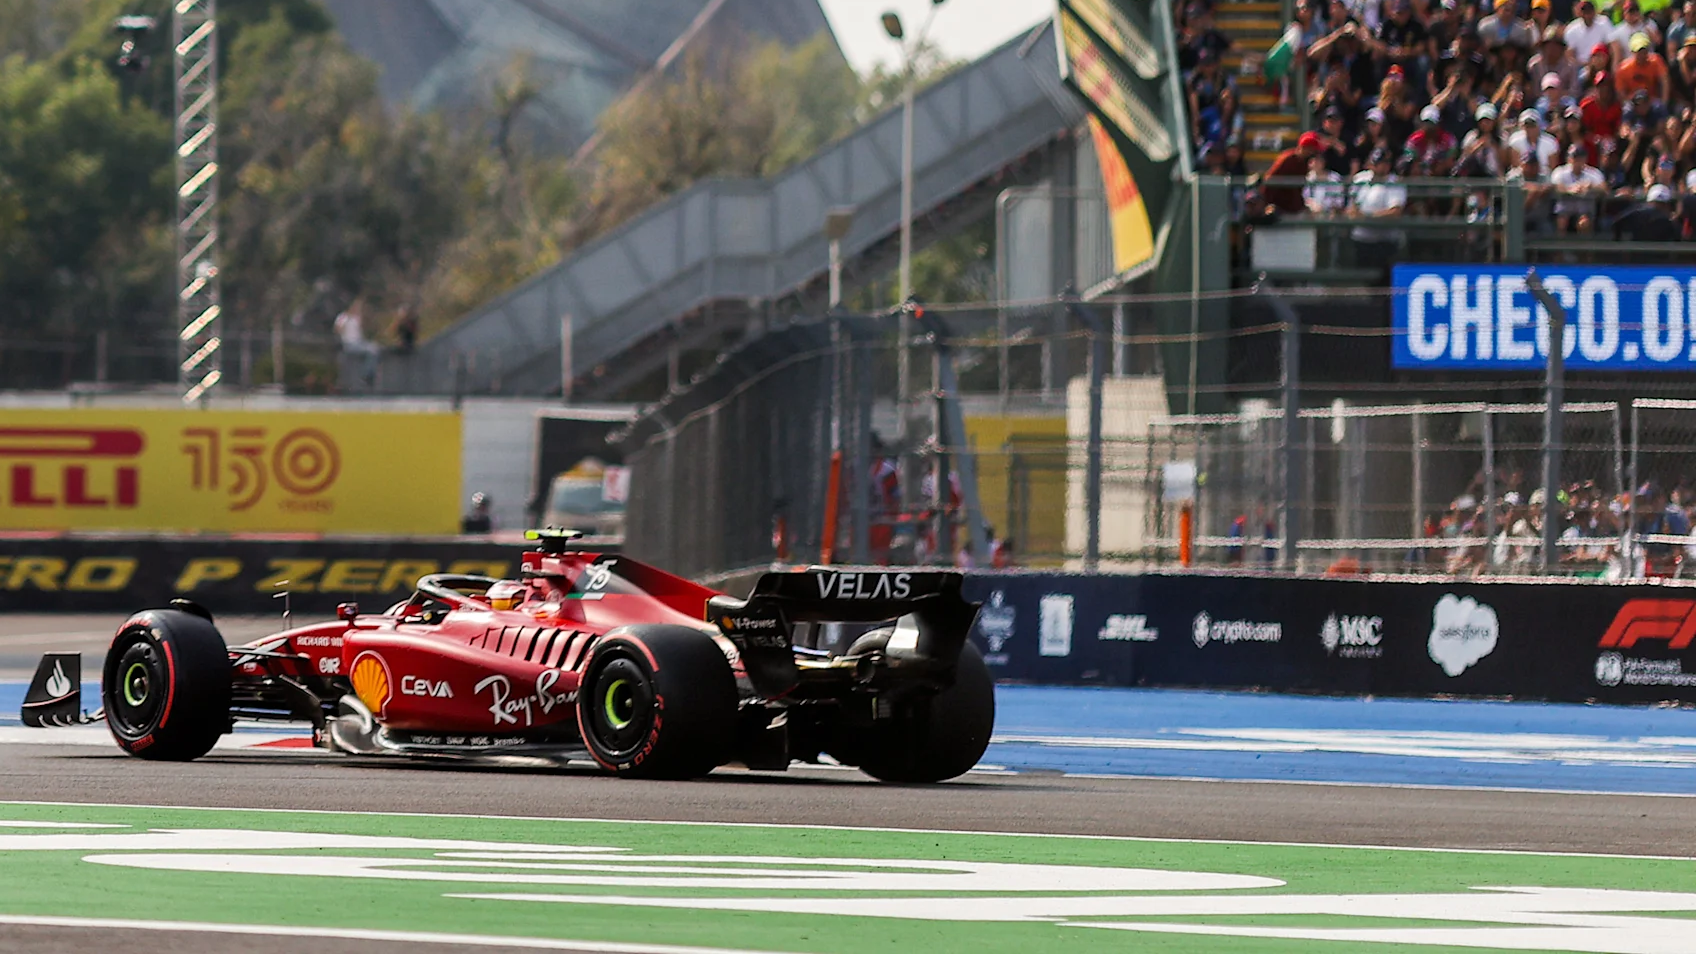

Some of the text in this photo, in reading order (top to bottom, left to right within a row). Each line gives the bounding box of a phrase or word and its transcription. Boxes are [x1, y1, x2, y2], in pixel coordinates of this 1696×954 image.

[181, 427, 341, 513] 150
[175, 558, 242, 591] P
[816, 572, 912, 599] VELAS
